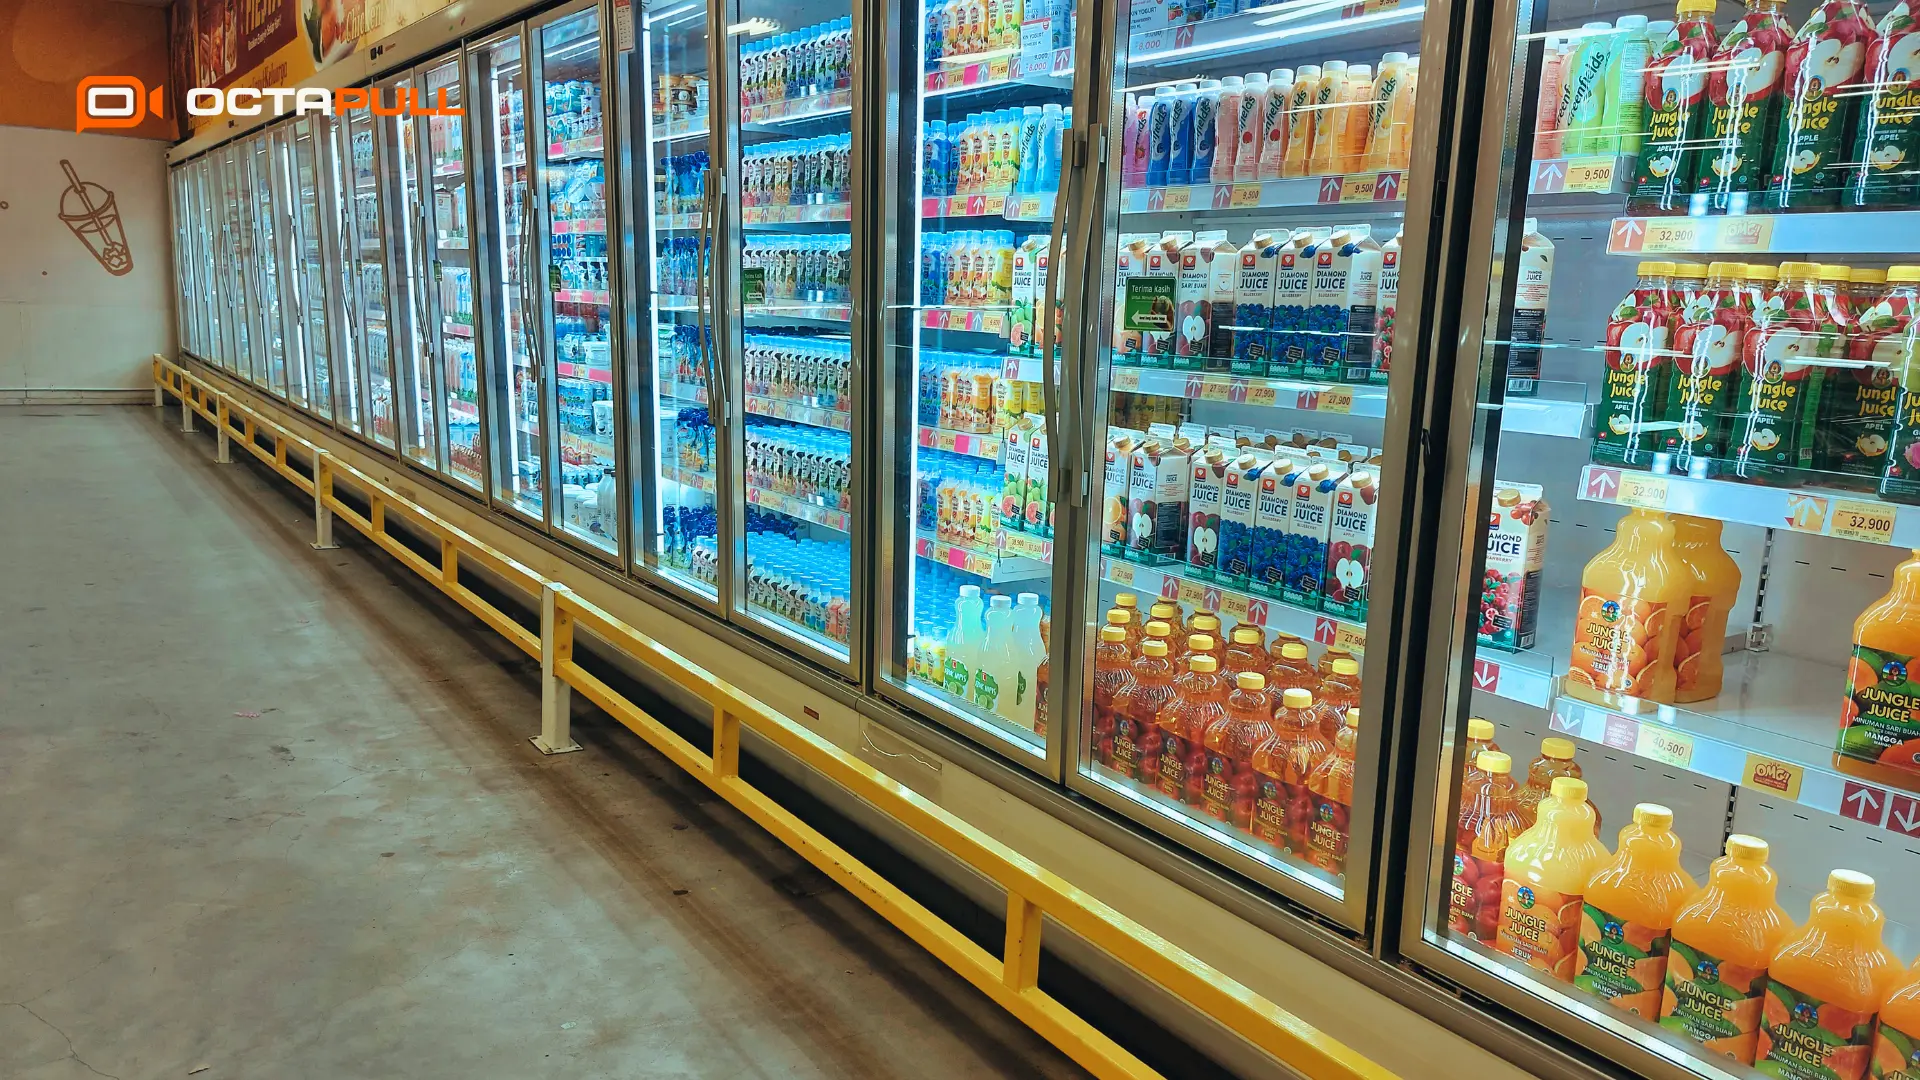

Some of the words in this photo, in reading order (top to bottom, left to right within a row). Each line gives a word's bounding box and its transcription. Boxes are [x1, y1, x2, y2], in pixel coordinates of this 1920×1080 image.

[1787, 97, 1838, 119] Jngle
[1584, 168, 1610, 181] 9,500
[1242, 190, 1259, 200] 9,500
[1354, 183, 1374, 194] 9,500
[1659, 230, 1693, 241] 32,900
[1013, 277, 1032, 286] JUICE
[1280, 271, 1309, 279] DIAMOND
[1131, 284, 1153, 293] Terima
[1154, 284, 1171, 293] Kasih
[1239, 279, 1269, 289] JUICE
[1278, 279, 1308, 290] JUICE
[1314, 278, 1346, 289] JUICE
[1255, 388, 1275, 399] 27,900
[1328, 395, 1351, 406] 27,900
[1756, 417, 1775, 425] APEL
[1865, 422, 1885, 431] APEL
[1007, 452, 1025, 464] JUICE
[1030, 457, 1048, 469] JUICE
[1131, 477, 1154, 490] JUICE
[1194, 483, 1220, 492] DIAMOND
[1192, 489, 1219, 502] JUICE
[1225, 488, 1252, 499] DIAMOND
[1260, 494, 1289, 505] DIAMOND
[1223, 495, 1251, 510] JUICE
[1258, 502, 1288, 516] JUICE
[1295, 501, 1325, 512] DIAMOND
[1293, 510, 1324, 524] JUICE
[1336, 508, 1368, 520] DIAMOND
[1334, 515, 1367, 532] JUICE
[1849, 514, 1891, 532] 32,900
[1488, 532, 1522, 543] AMOND
[1487, 540, 1521, 555] UICE
[1591, 661, 1608, 671] JERU
[1861, 687, 1920, 711] JUNGLE
[1867, 703, 1911, 723] JUICE
[1852, 715, 1885, 729] MINUMAN
[1885, 724, 1902, 733] SARI
[1114, 735, 1136, 751] JUNGLE
[1652, 735, 1685, 757] 40,500
[1864, 731, 1904, 746] MANGGA
[1873, 740, 1892, 748] MANGO
[1115, 746, 1132, 760] JUICE
[1160, 753, 1183, 770] JUNGLE
[1162, 765, 1179, 779] JUICE
[1755, 763, 1791, 784] OMG!
[1205, 774, 1229, 792] JUNGLE
[1207, 786, 1225, 801] JUICE
[1256, 798, 1285, 818] JUNGLE
[1260, 810, 1281, 826] JUICE
[1311, 821, 1342, 842] JUNGLE
[1313, 834, 1336, 851] JUICE
[1505, 906, 1546, 932] JUNGLE
[1509, 921, 1539, 942] JUICE
[1511, 947, 1532, 960] JERUK
[1589, 941, 1636, 969] JUNGLE
[1593, 957, 1628, 979] JUICE
[1583, 965, 1608, 982] MINUMAN
[1608, 978, 1621, 987] SARI
[1621, 983, 1637, 993] BUAH
[1591, 981, 1623, 999] MANGGA
[1680, 980, 1732, 1011] JUNGLE
[1684, 997, 1723, 1022] JUICE
[1671, 1006, 1700, 1024] MINUMAN
[1701, 1019, 1715, 1030] SARI
[1715, 1025, 1733, 1037] BUAH
[1682, 1023, 1717, 1042] MANGGA
[1776, 1023, 1833, 1057] JUNGLE
[1780, 1040, 1823, 1068] JUICE
[1767, 1049, 1798, 1070] MINUMAN
[1798, 1064, 1814, 1076] SARI
